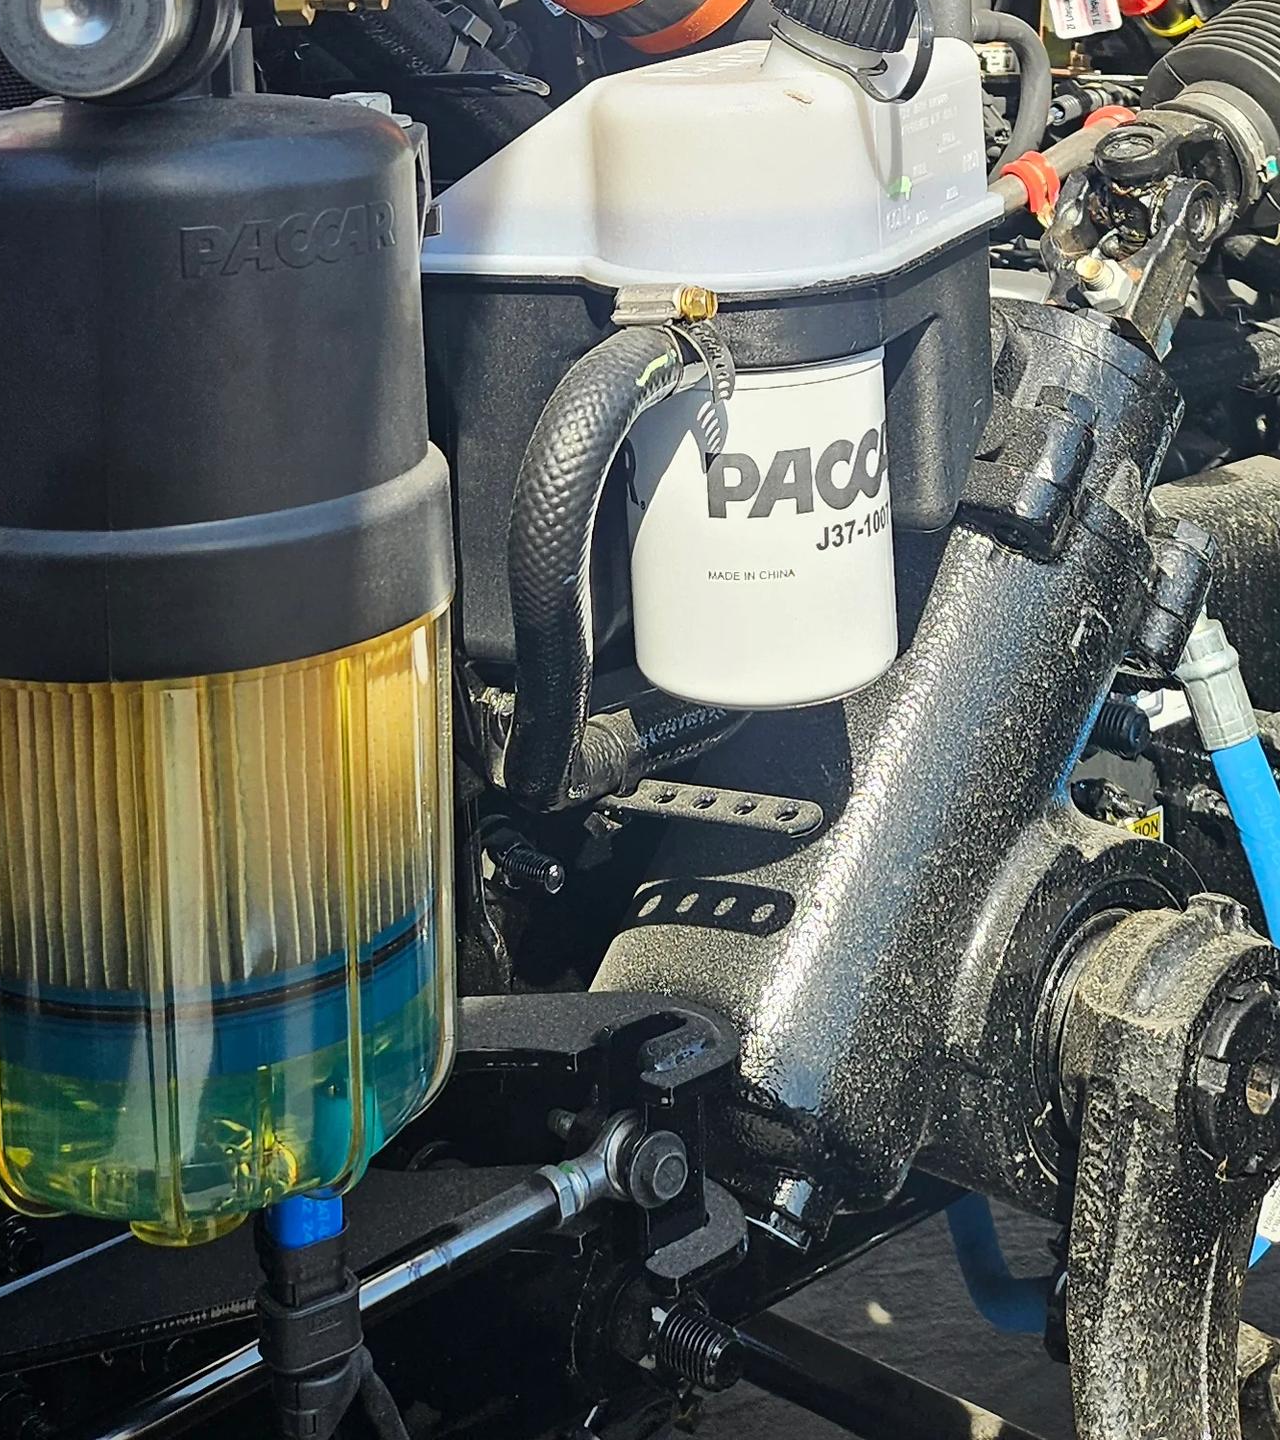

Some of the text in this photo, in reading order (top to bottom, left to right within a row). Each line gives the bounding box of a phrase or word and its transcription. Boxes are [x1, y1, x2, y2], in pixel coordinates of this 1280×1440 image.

[179, 200, 396, 279] PACCAR
[707, 421, 888, 519] PACC
[708, 568, 796, 581] MADE IN CHINA
